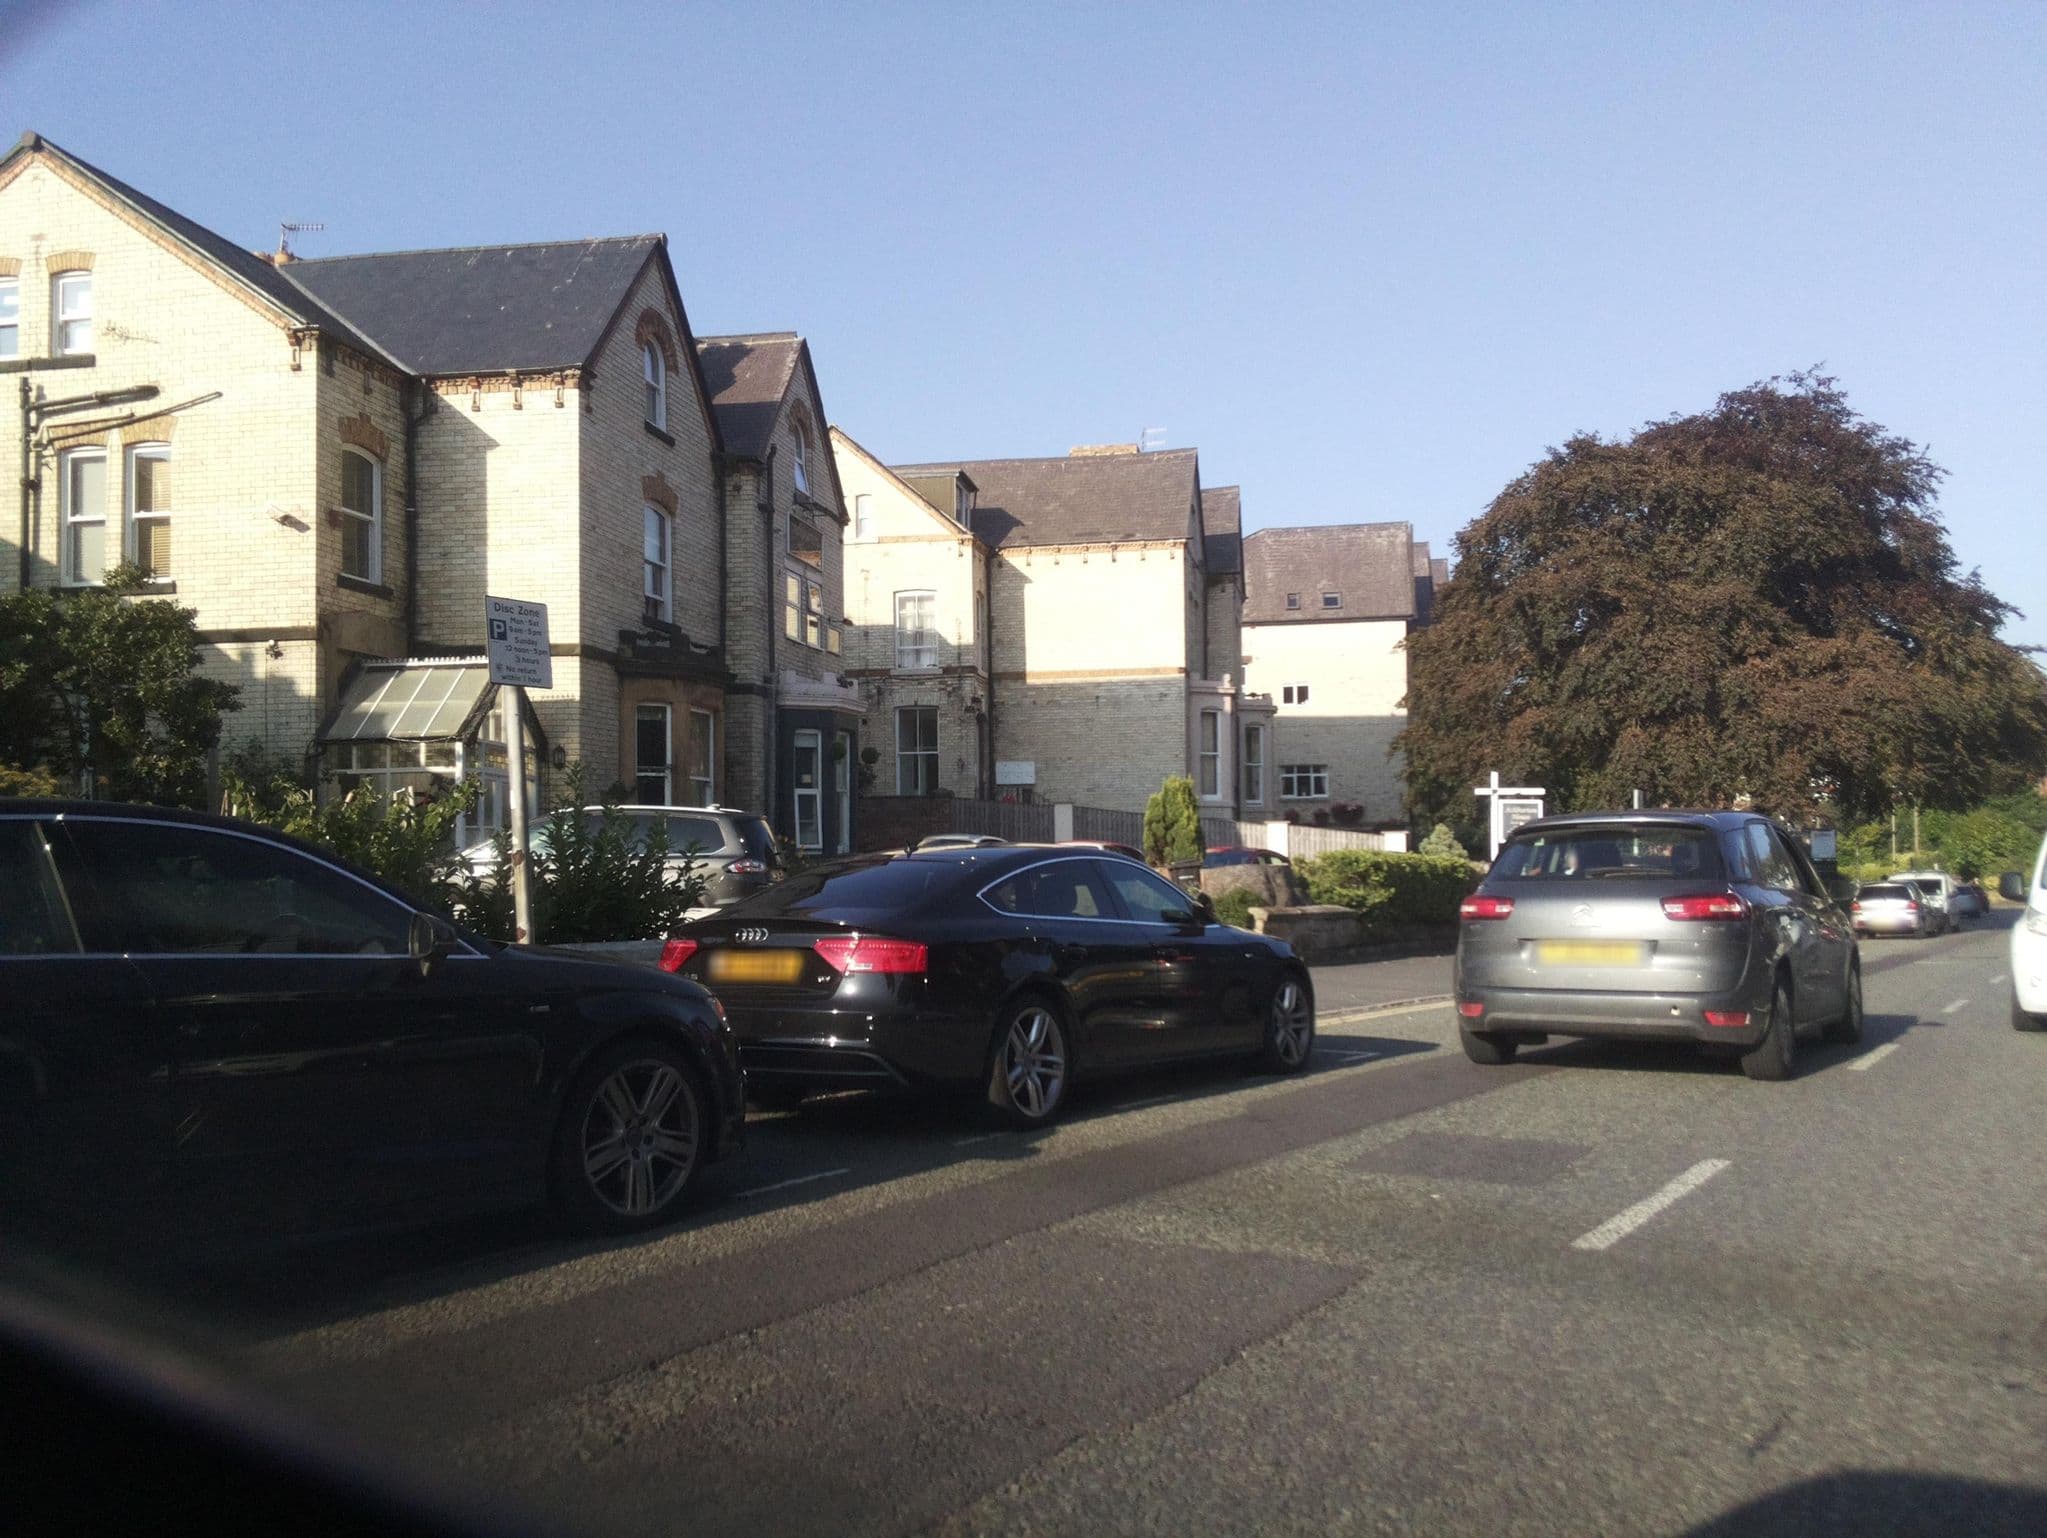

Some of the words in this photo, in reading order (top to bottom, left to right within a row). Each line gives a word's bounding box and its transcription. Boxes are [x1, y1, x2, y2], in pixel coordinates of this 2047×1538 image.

[494, 602, 514, 614] Disc
[518, 606, 540, 618] Zone
[493, 620, 505, 638] P
[514, 637, 538, 646] Sunday
[521, 656, 540, 665] hours
[516, 667, 537, 675] return
